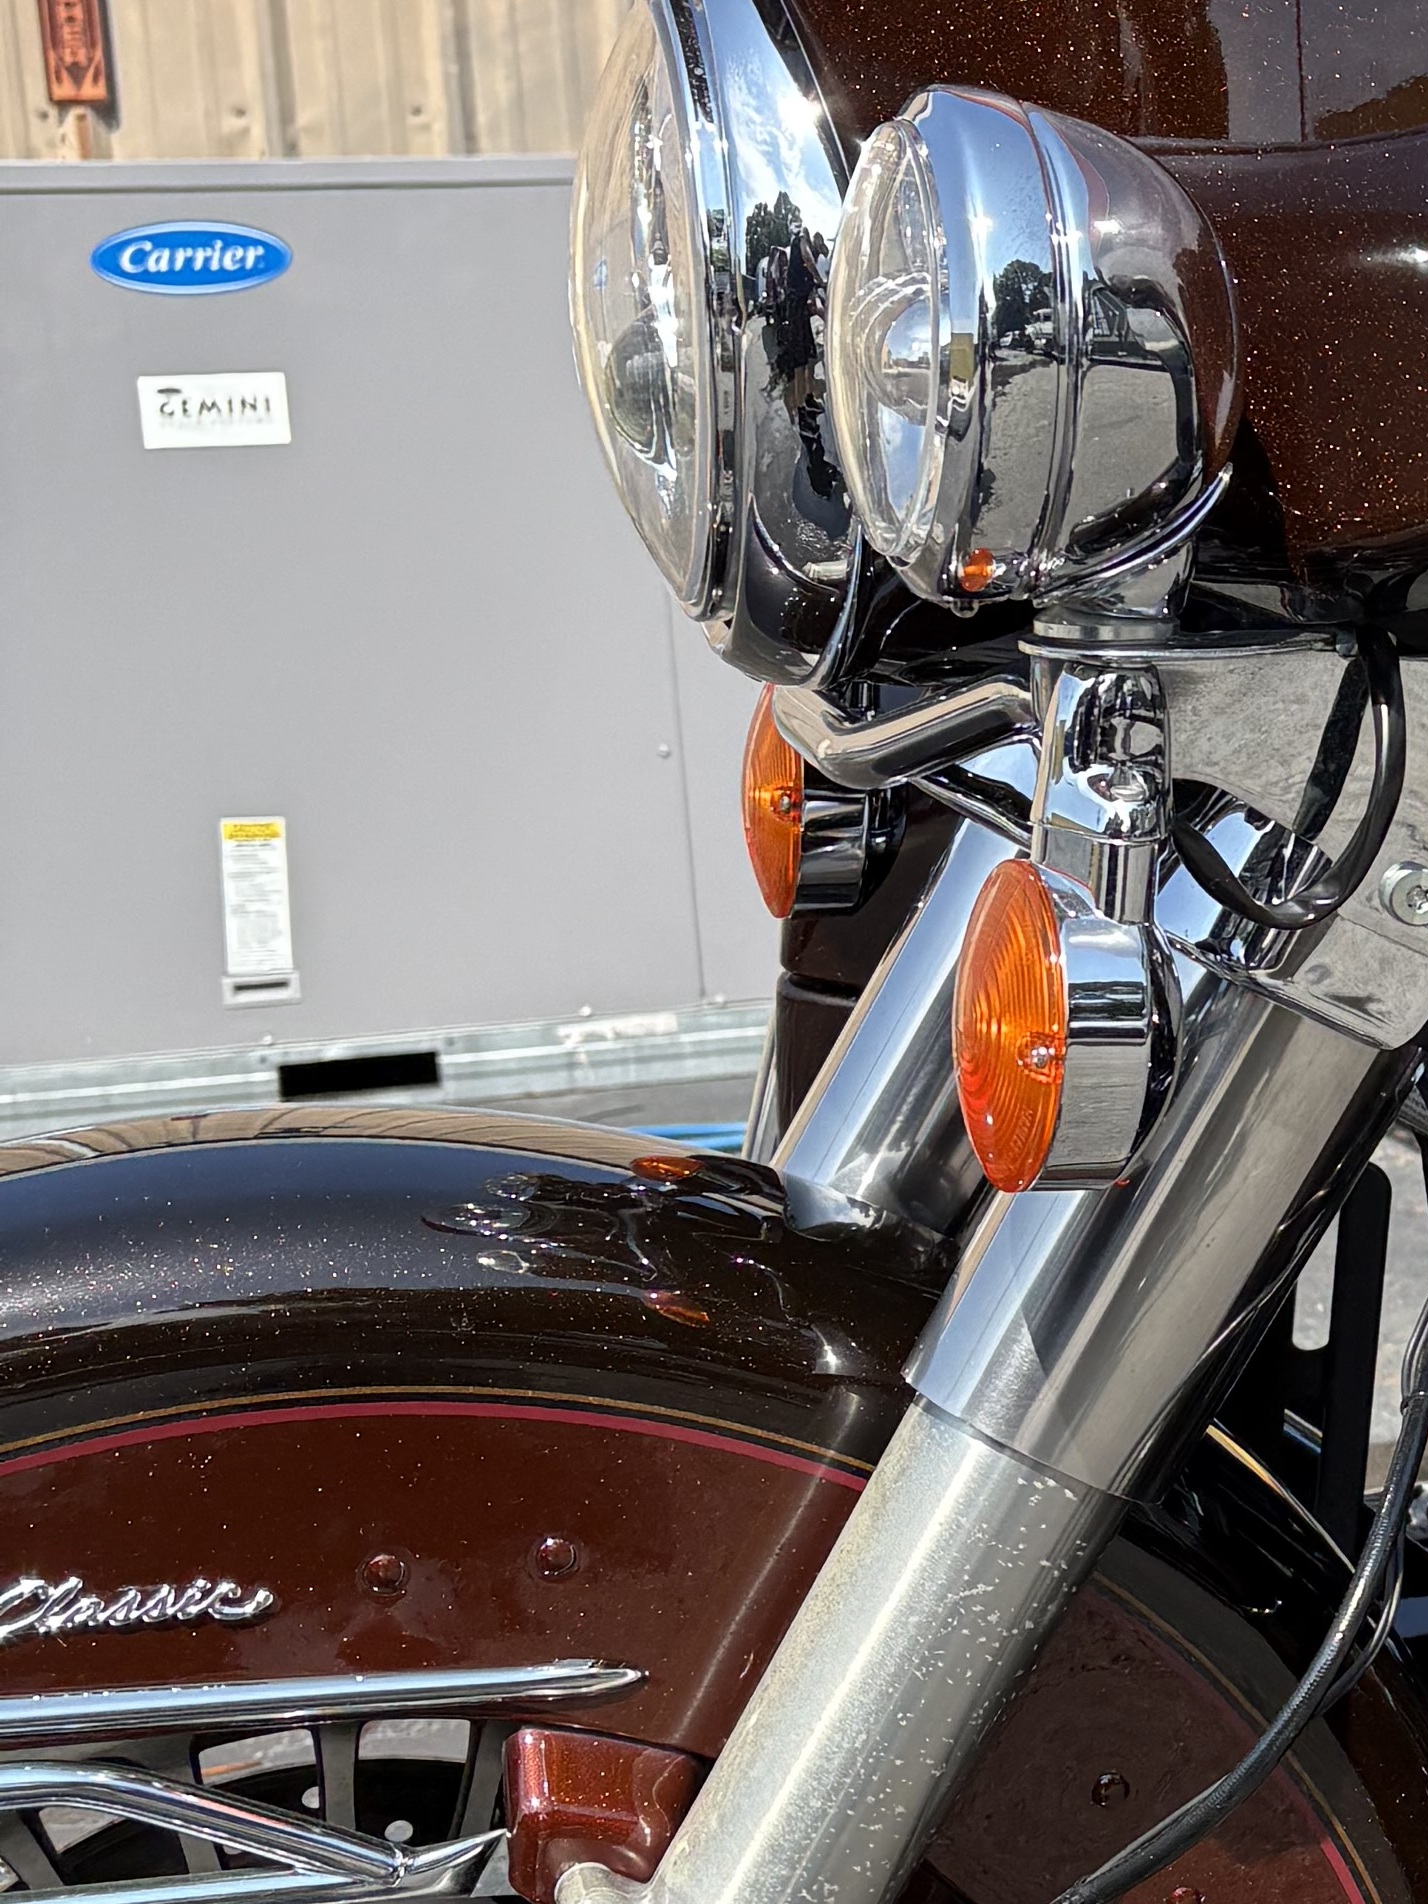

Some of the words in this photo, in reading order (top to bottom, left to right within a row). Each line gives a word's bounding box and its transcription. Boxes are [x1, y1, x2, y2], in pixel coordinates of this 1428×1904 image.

[119, 239, 265, 274] Carrier
[157, 388, 272, 418] GEMINI
[0, 1575, 275, 1644] Classic
